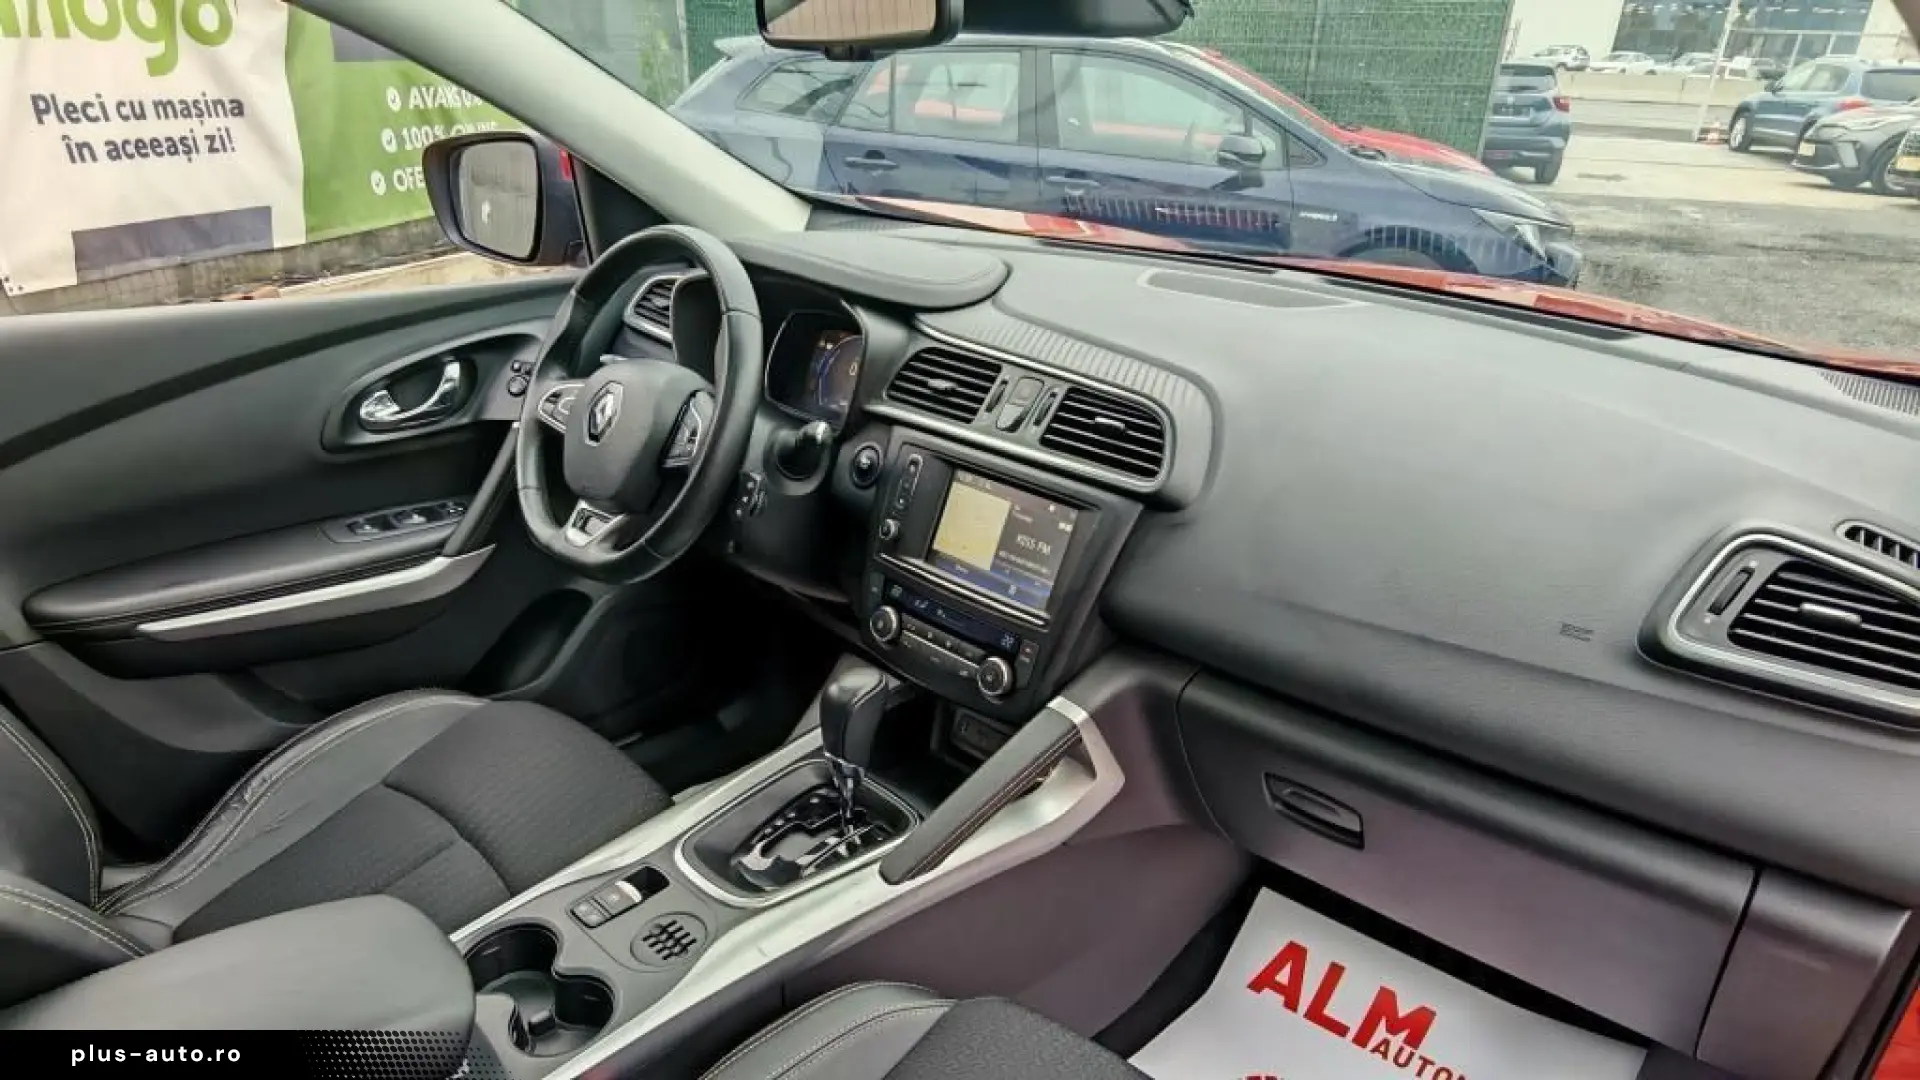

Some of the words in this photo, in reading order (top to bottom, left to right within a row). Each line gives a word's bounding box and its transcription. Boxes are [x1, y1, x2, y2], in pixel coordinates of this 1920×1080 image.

[30, 93, 111, 124] Pleci
[115, 99, 147, 121] cu
[152, 91, 244, 126] mașina
[62, 134, 98, 163] în
[104, 128, 200, 162] aceeași
[204, 126, 236, 153] zi!
[1246, 940, 1436, 1050] ALM
